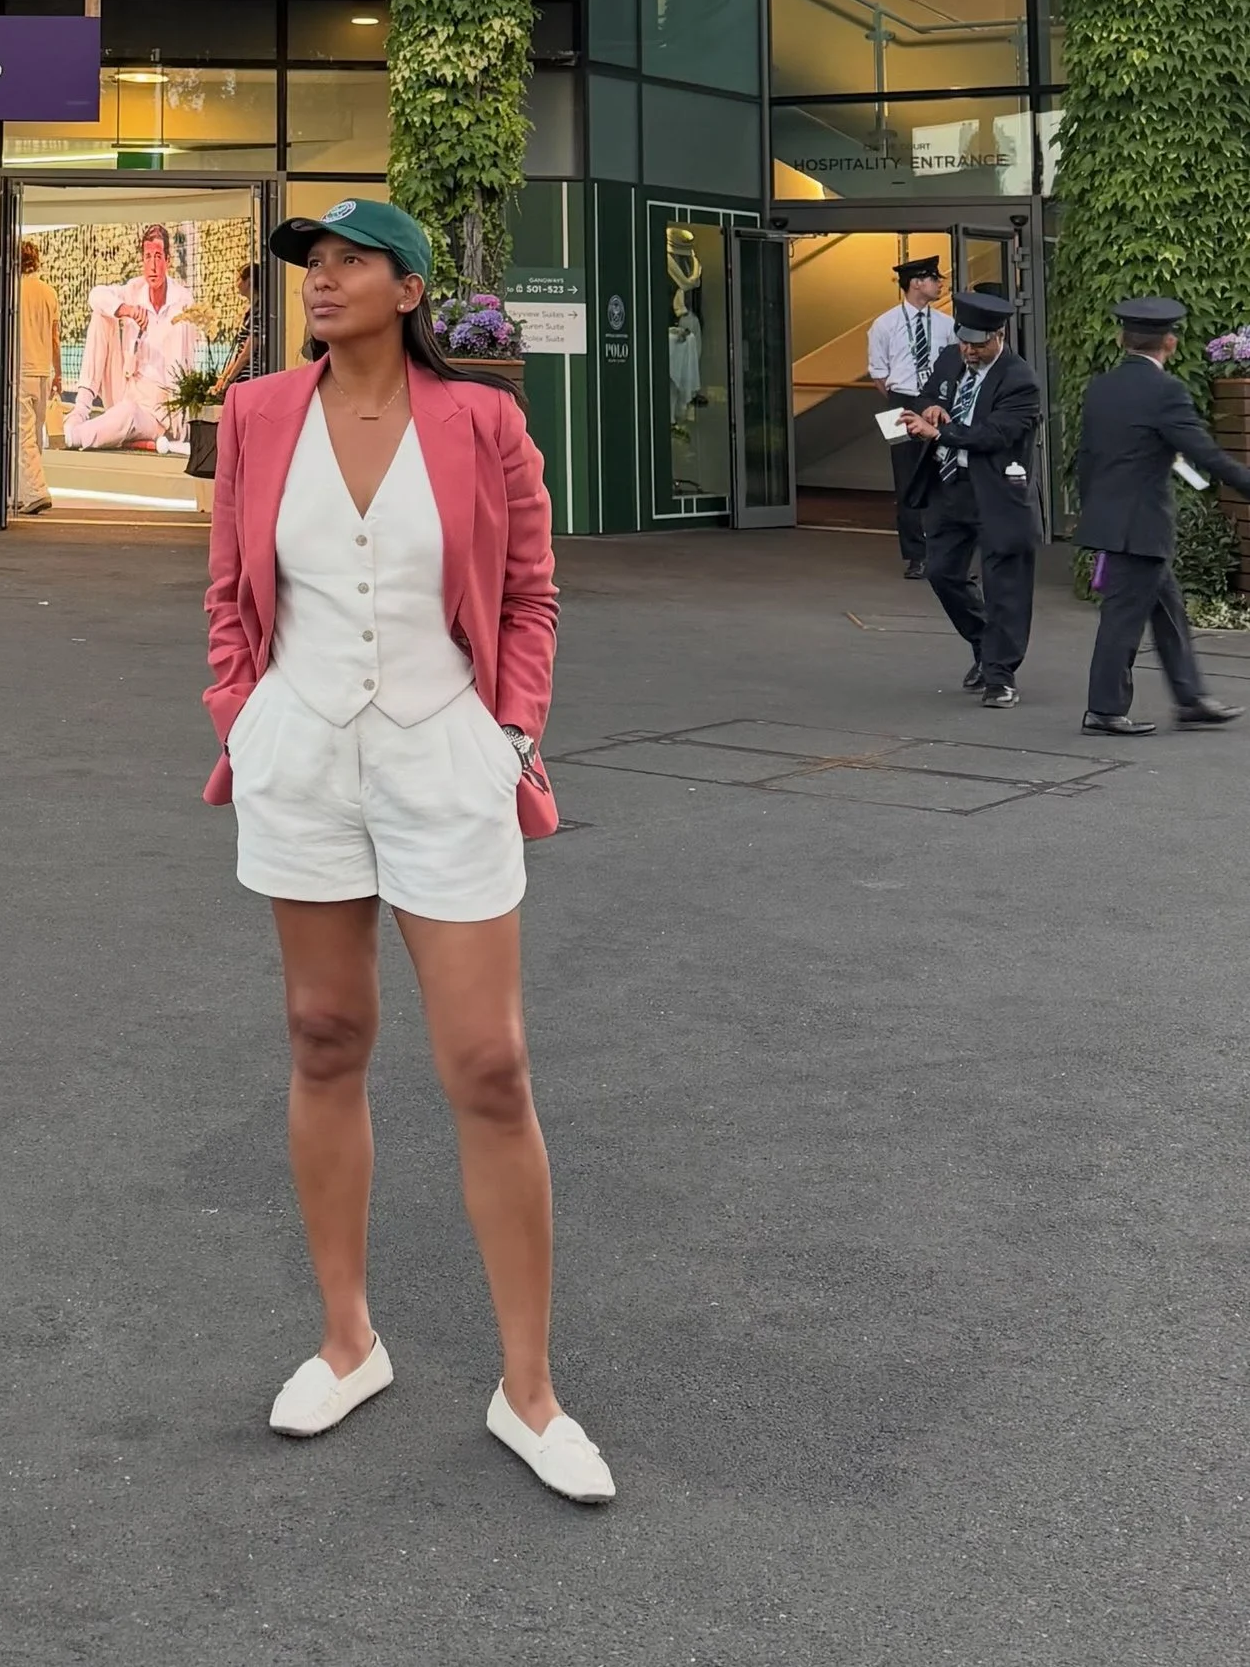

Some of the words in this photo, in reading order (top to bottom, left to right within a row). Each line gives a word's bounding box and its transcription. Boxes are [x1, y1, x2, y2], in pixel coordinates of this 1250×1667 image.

[793, 157, 901, 172] HOSPITALITY
[911, 153, 1010, 170] ENTRANCE
[605, 342, 629, 359] POLO
